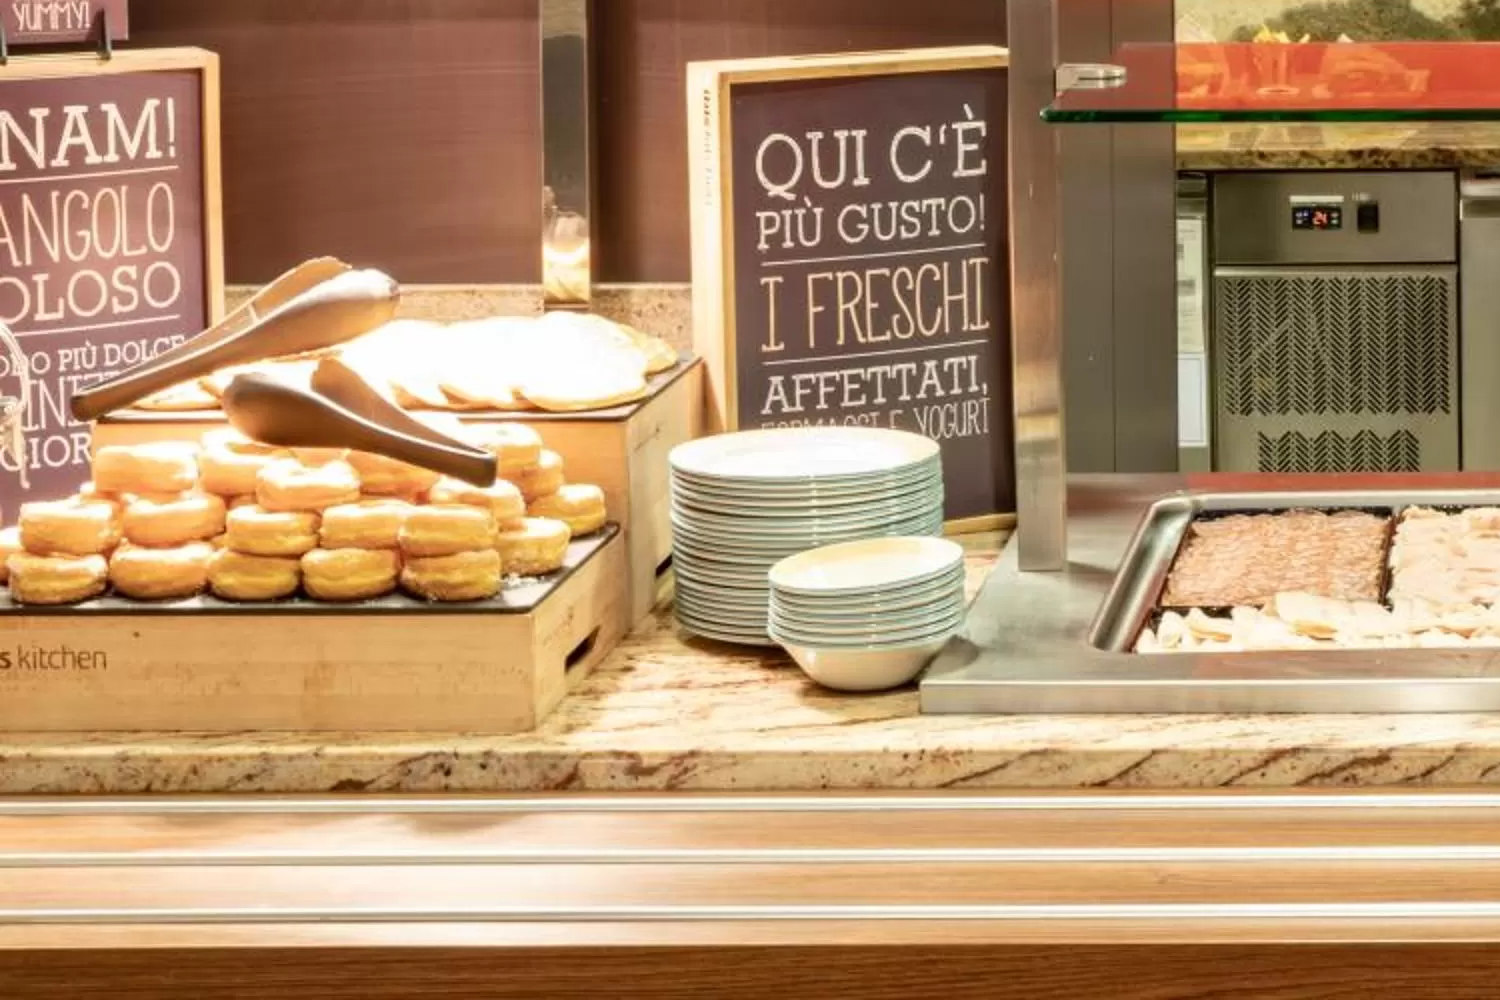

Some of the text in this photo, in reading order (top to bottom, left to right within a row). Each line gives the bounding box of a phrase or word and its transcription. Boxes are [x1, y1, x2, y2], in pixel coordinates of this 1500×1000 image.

[11, 0, 92, 31] YUMMY!
[755, 129, 871, 201] QUI
[755, 193, 986, 252] PIÙ GUSTO!
[760, 256, 991, 352] I FRESCHI
[57, 339, 98, 373] PIÙ
[760, 354, 989, 416] AFFETTATI,
[912, 397, 992, 441] YOGURT
[17, 643, 108, 673] kitchen
